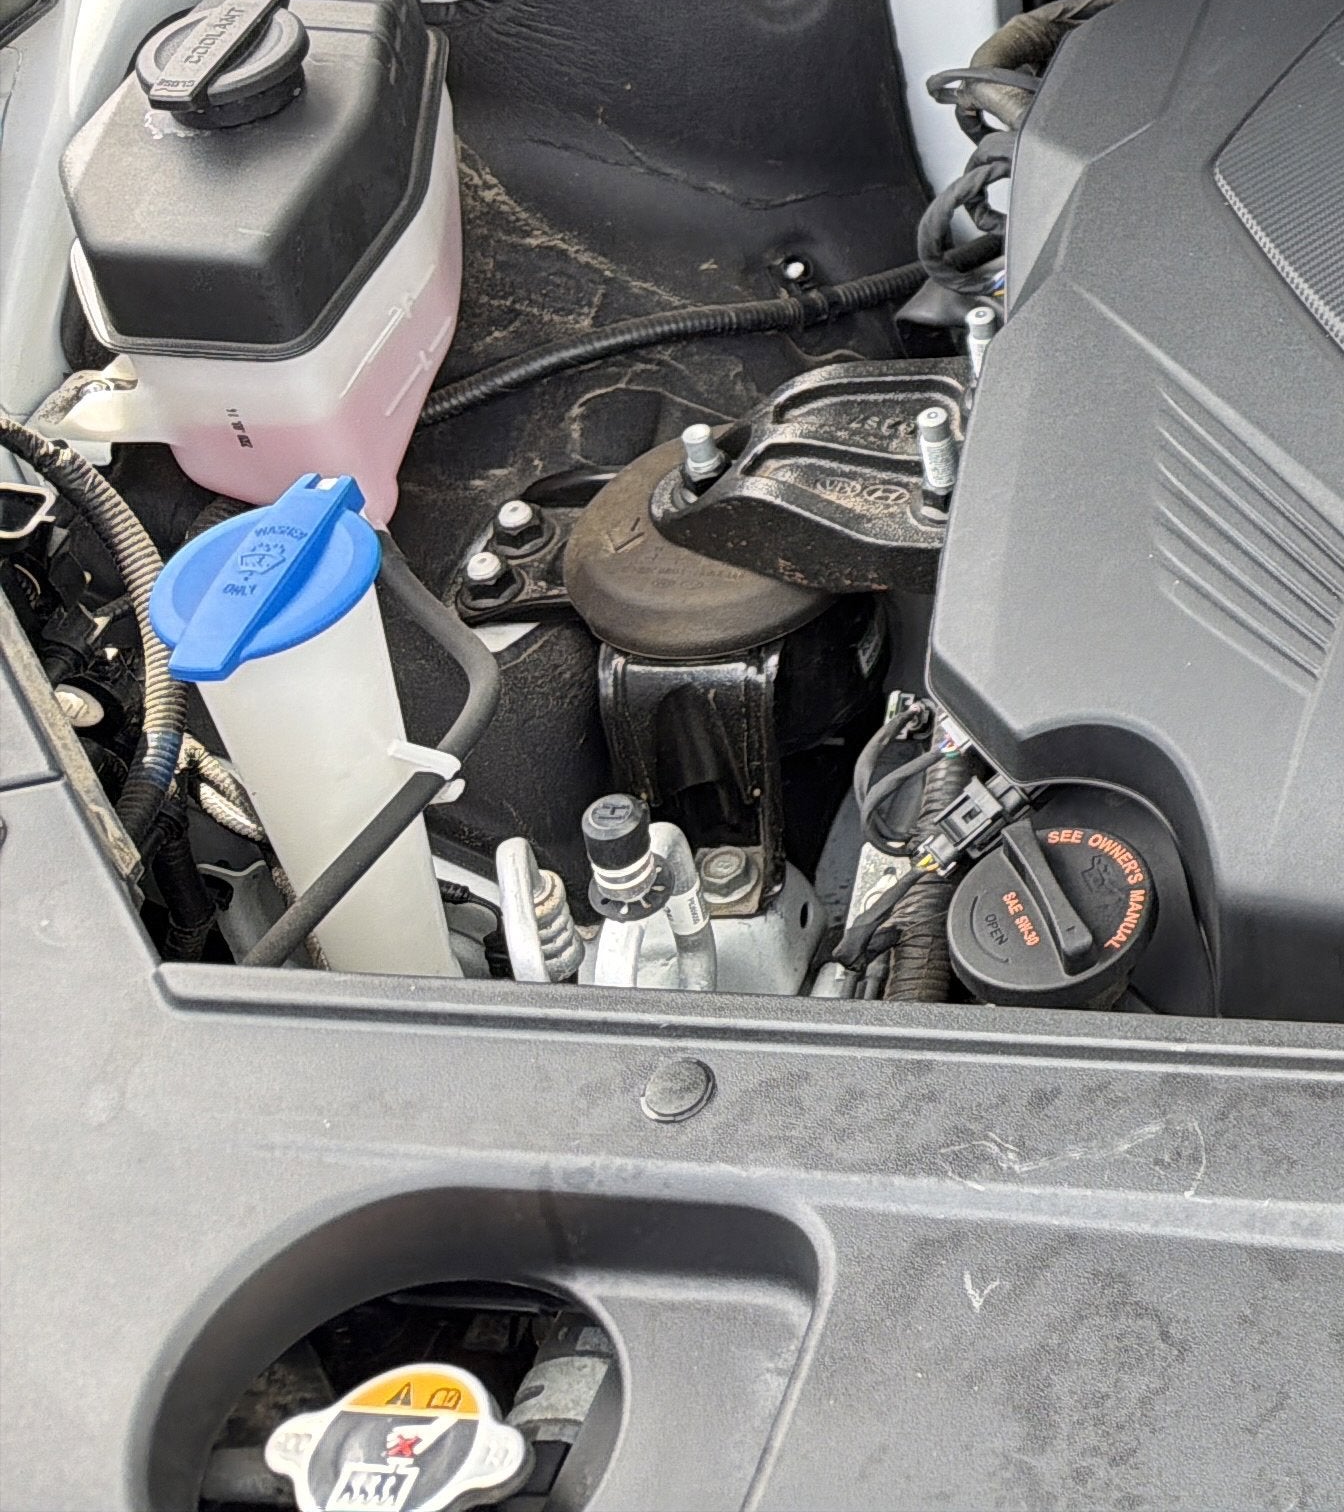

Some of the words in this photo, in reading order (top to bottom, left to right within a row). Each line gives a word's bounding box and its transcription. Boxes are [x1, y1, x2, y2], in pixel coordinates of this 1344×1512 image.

[184, 7, 245, 65] COOLANT
[223, 583, 258, 596] ONLY
[1046, 829, 1084, 844] SEE
[1088, 833, 1144, 885] OWNER'S
[984, 913, 1008, 946] OPEN
[1002, 891, 1024, 916] SAE
[1014, 915, 1040, 947] 5W-30
[1104, 889, 1146, 950] MANUAL
